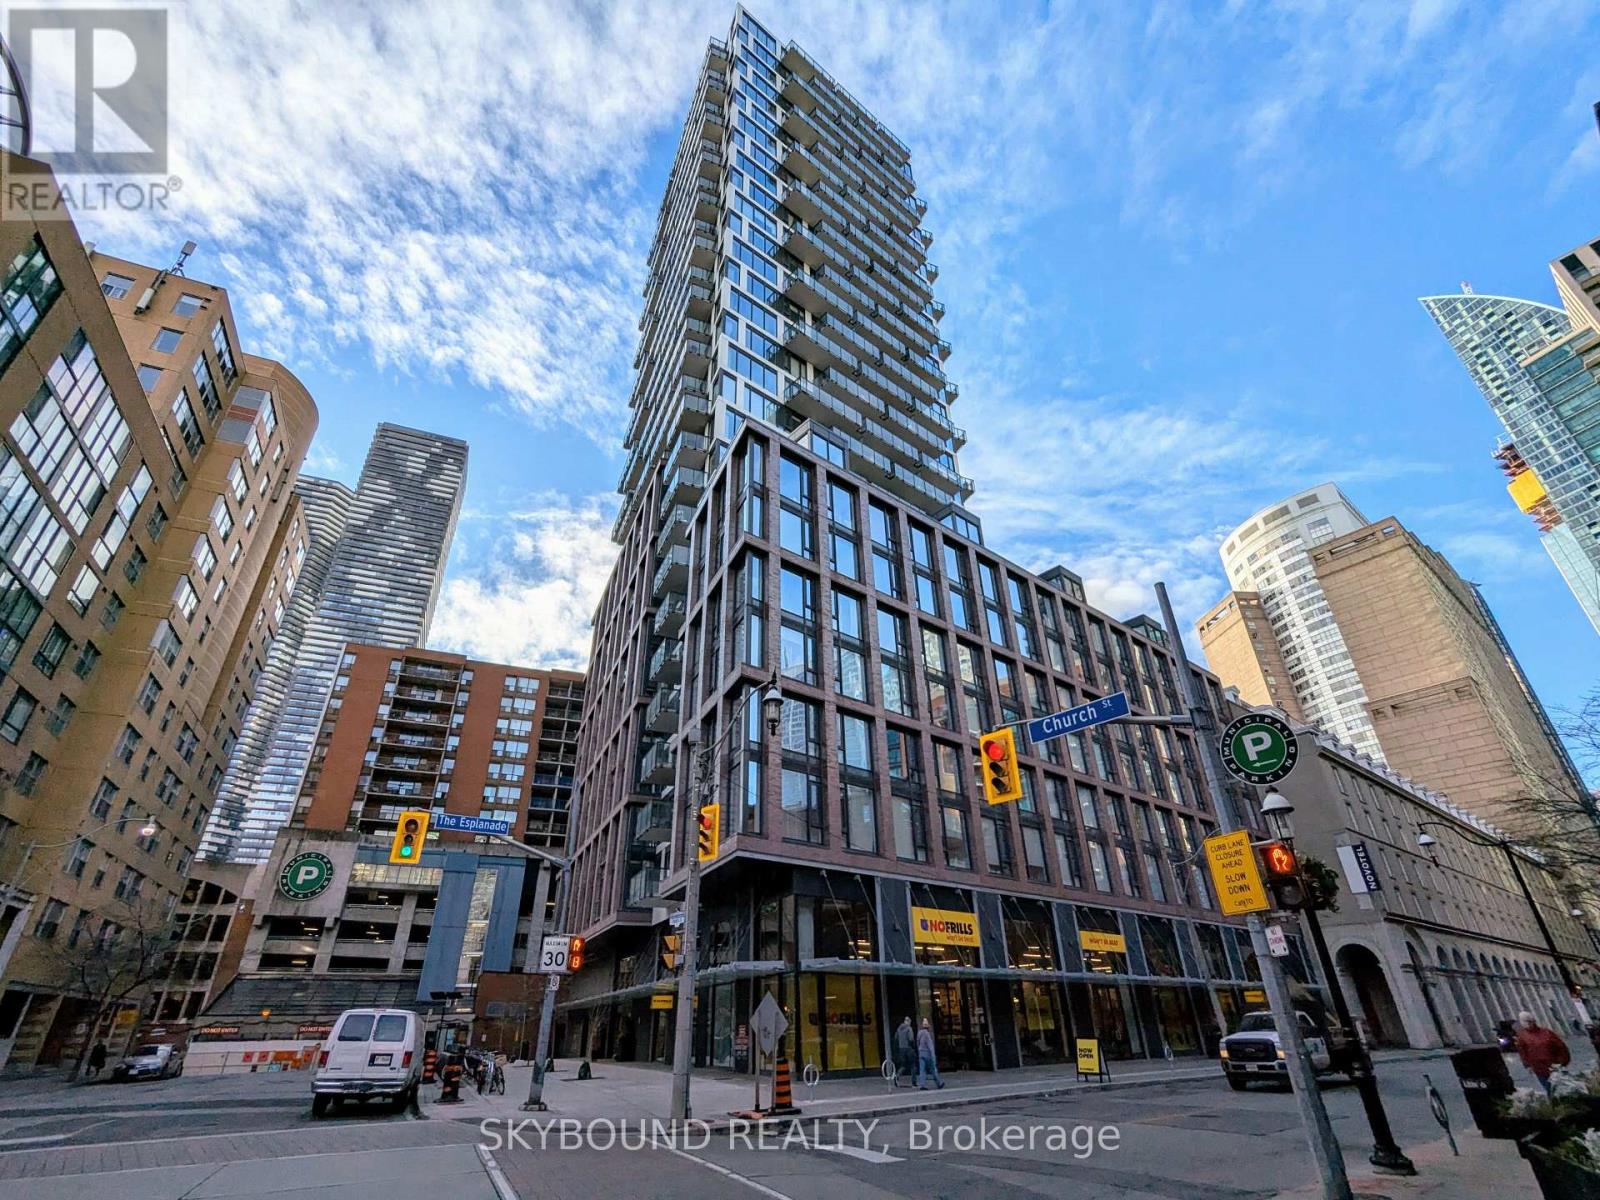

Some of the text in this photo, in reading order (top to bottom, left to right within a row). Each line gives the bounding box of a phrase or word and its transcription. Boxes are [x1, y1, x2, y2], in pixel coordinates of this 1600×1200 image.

[1042, 699, 1112, 733] Church St
[1223, 717, 1289, 756] MUNICIPAL
[1229, 746, 1296, 782] PARKING
[439, 814, 507, 832] The Esplanade
[1355, 846, 1377, 889] NOVOTEL
[1225, 872, 1246, 883] SLOW
[1227, 884, 1251, 895] DOWN
[929, 919, 973, 935] NOFRILLS
[543, 951, 565, 967] 30
